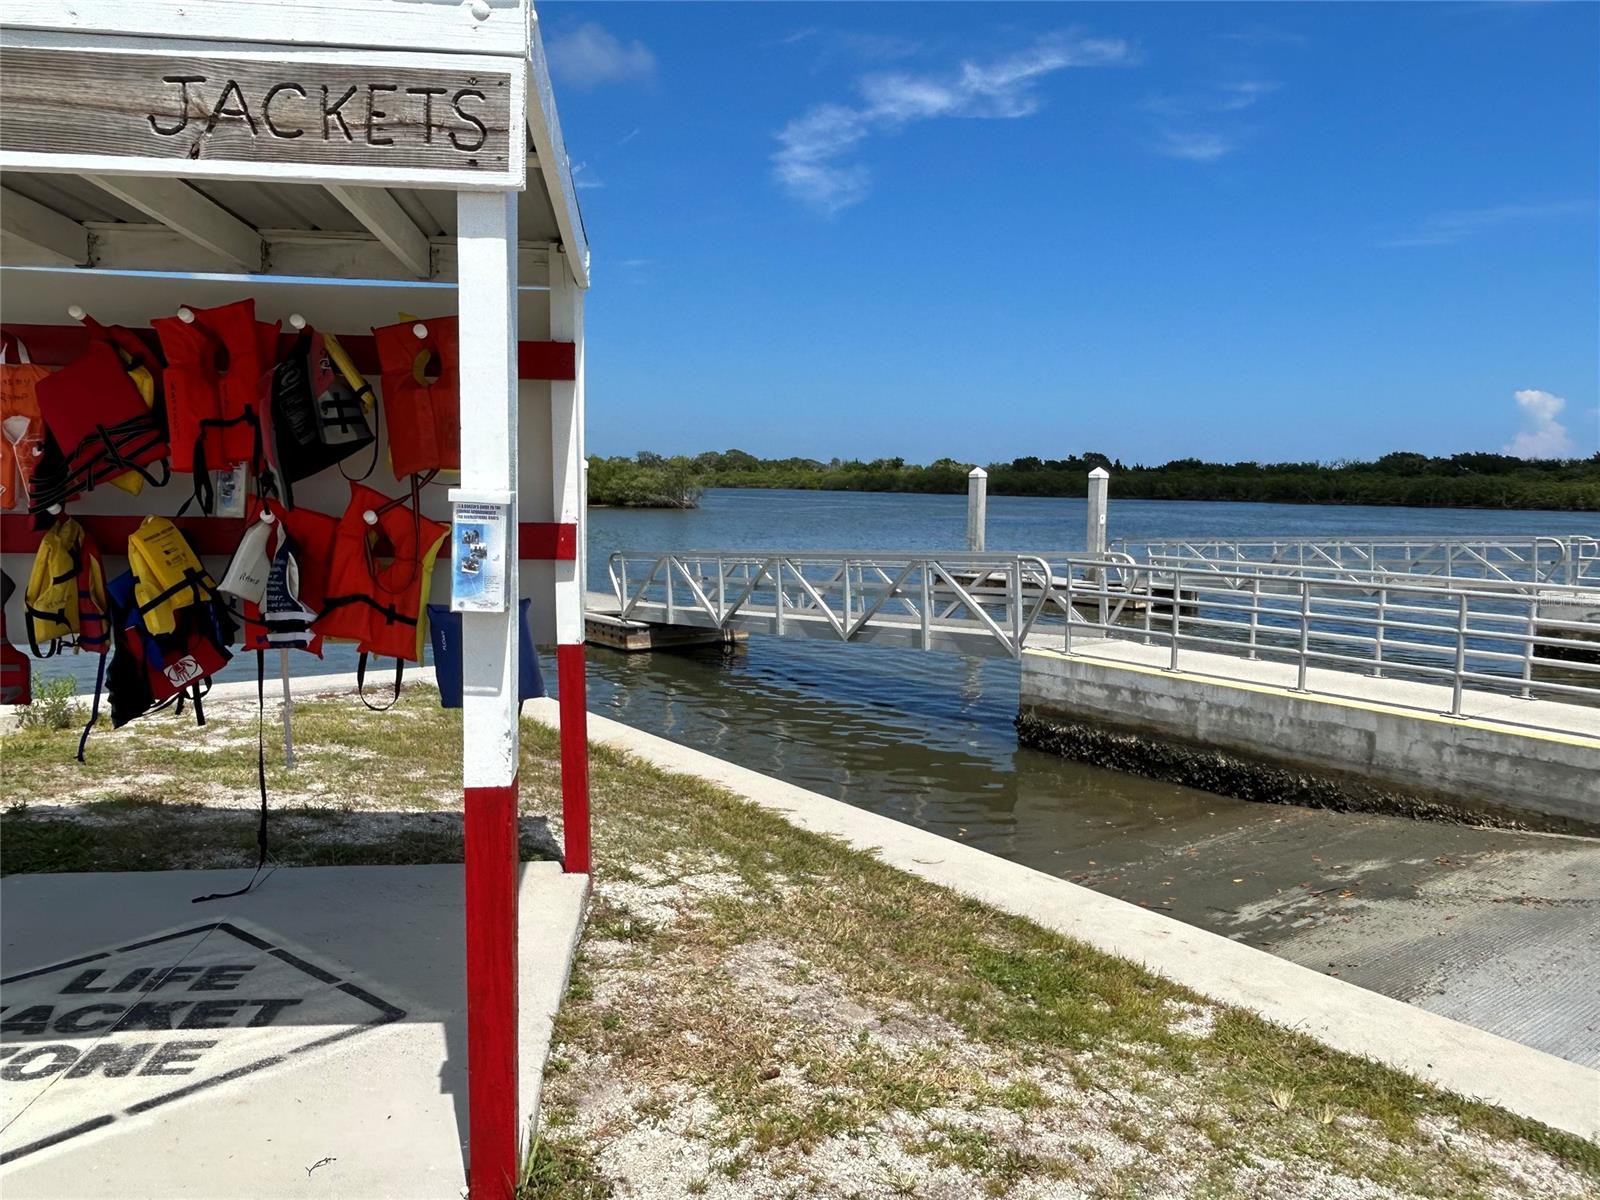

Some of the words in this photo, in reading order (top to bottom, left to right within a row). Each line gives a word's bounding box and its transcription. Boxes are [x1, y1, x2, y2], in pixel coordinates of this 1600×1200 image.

[146, 75, 489, 153] JACKETS
[59, 964, 256, 994] LIFE
[0, 999, 302, 1035] ACKET
